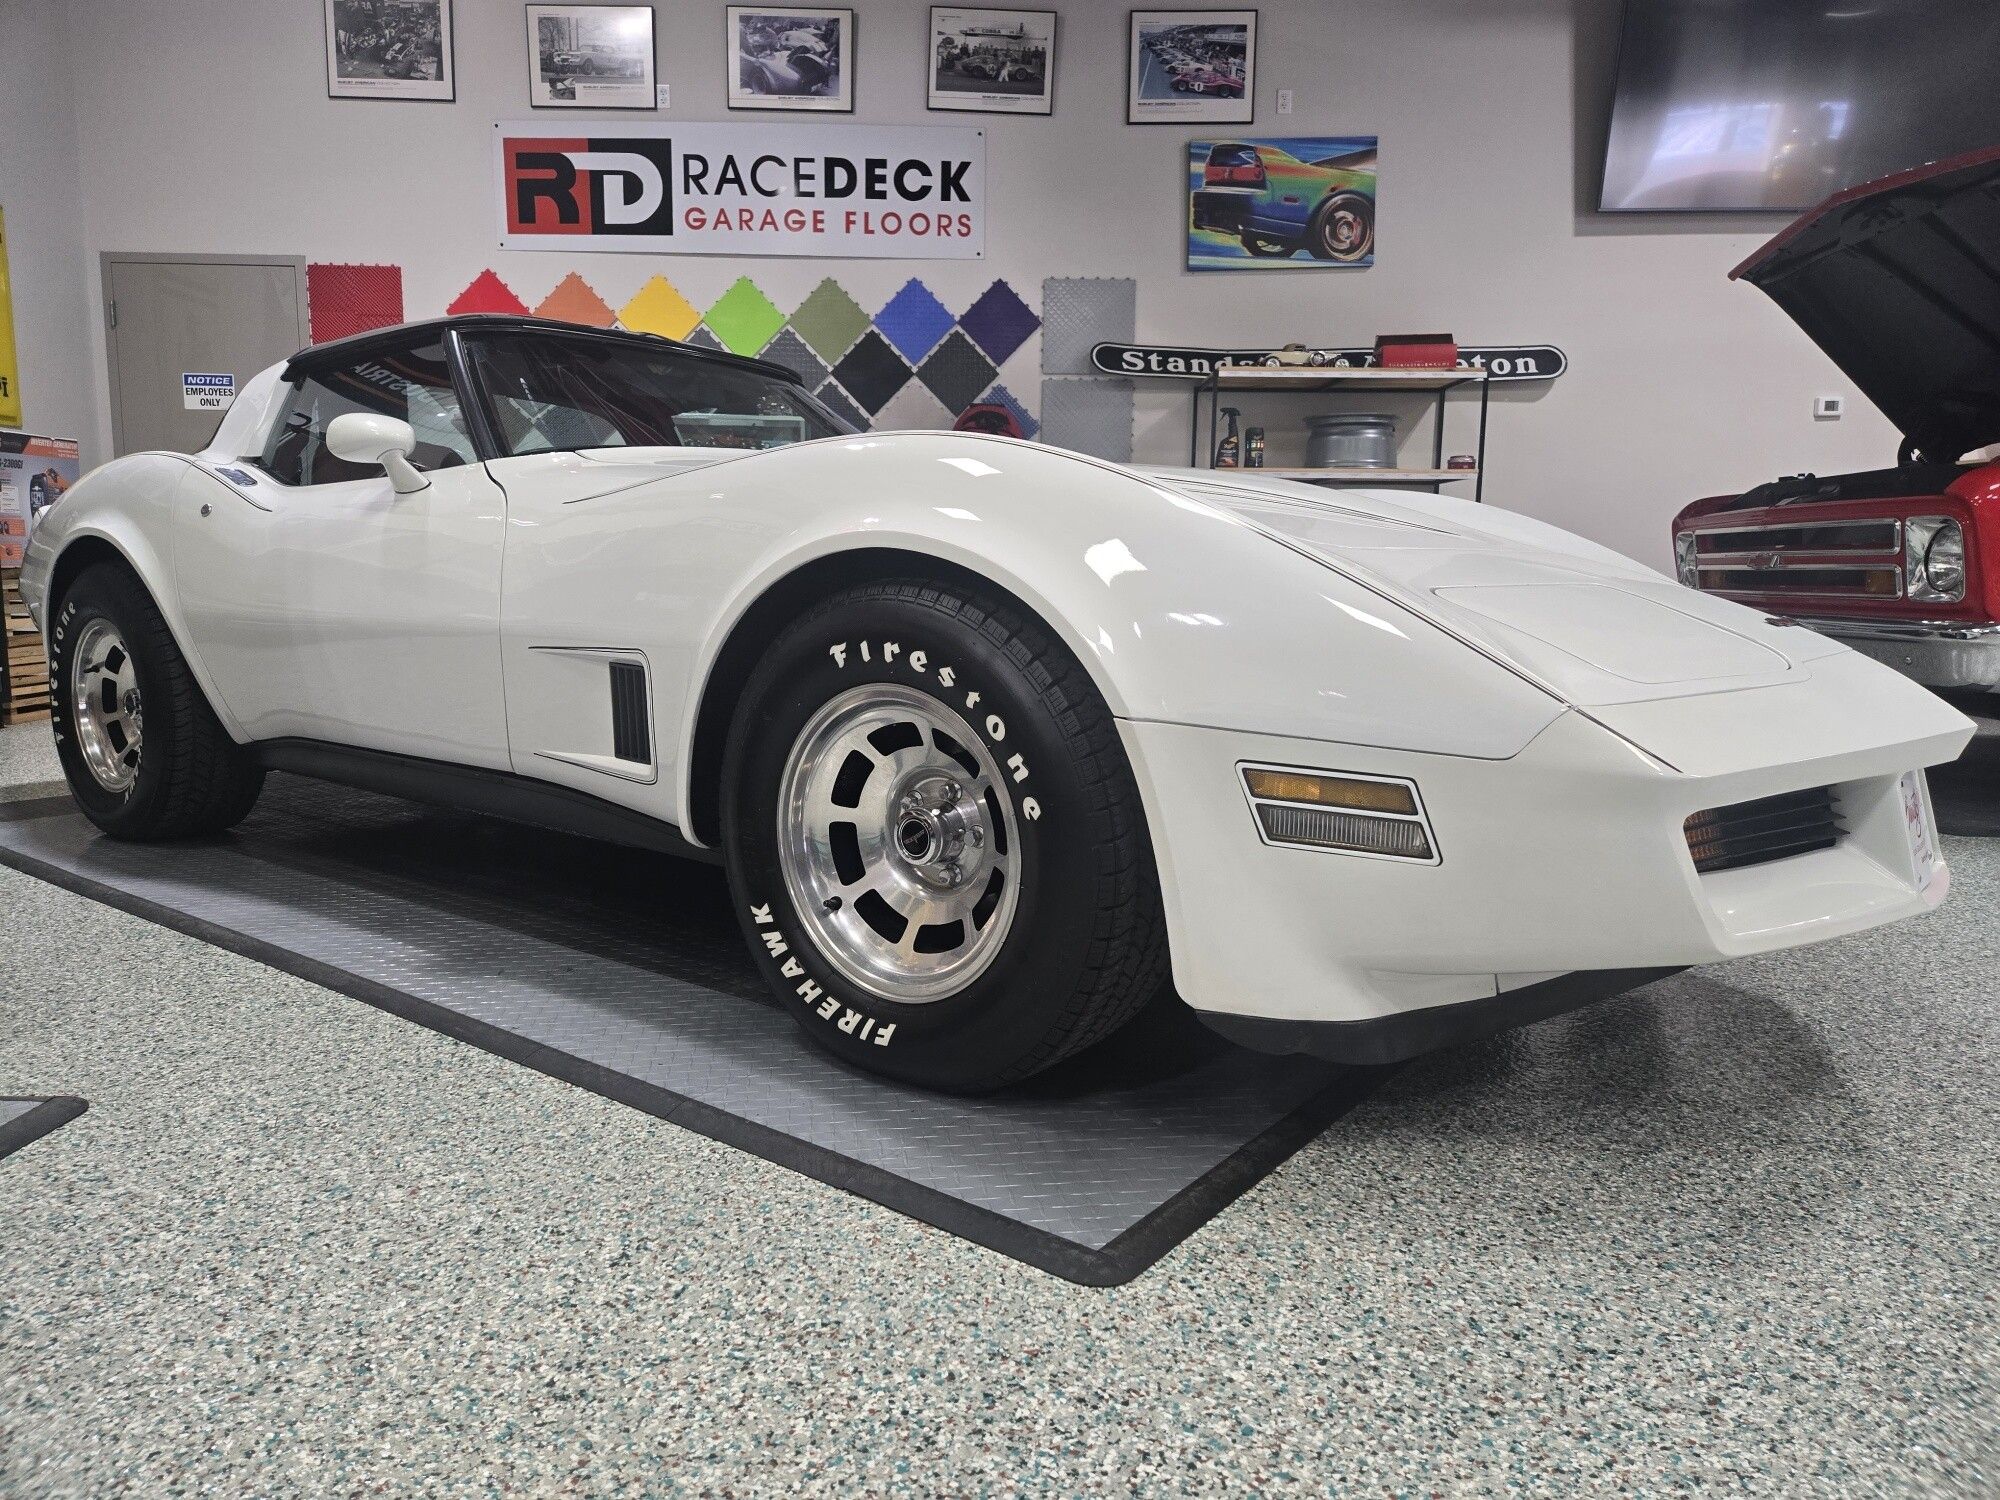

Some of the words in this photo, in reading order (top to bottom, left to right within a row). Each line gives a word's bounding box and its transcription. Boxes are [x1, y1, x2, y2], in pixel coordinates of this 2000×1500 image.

[516, 152, 664, 225] RD
[683, 153, 972, 202] RACEDECK
[684, 207, 825, 233] GARAGE
[844, 211, 972, 238] FLOORS
[185, 387, 234, 397] EMPLOYEES
[187, 376, 231, 385] NOTICE
[200, 398, 221, 407] ONLY
[749, 903, 897, 1048] FIREHAWK
